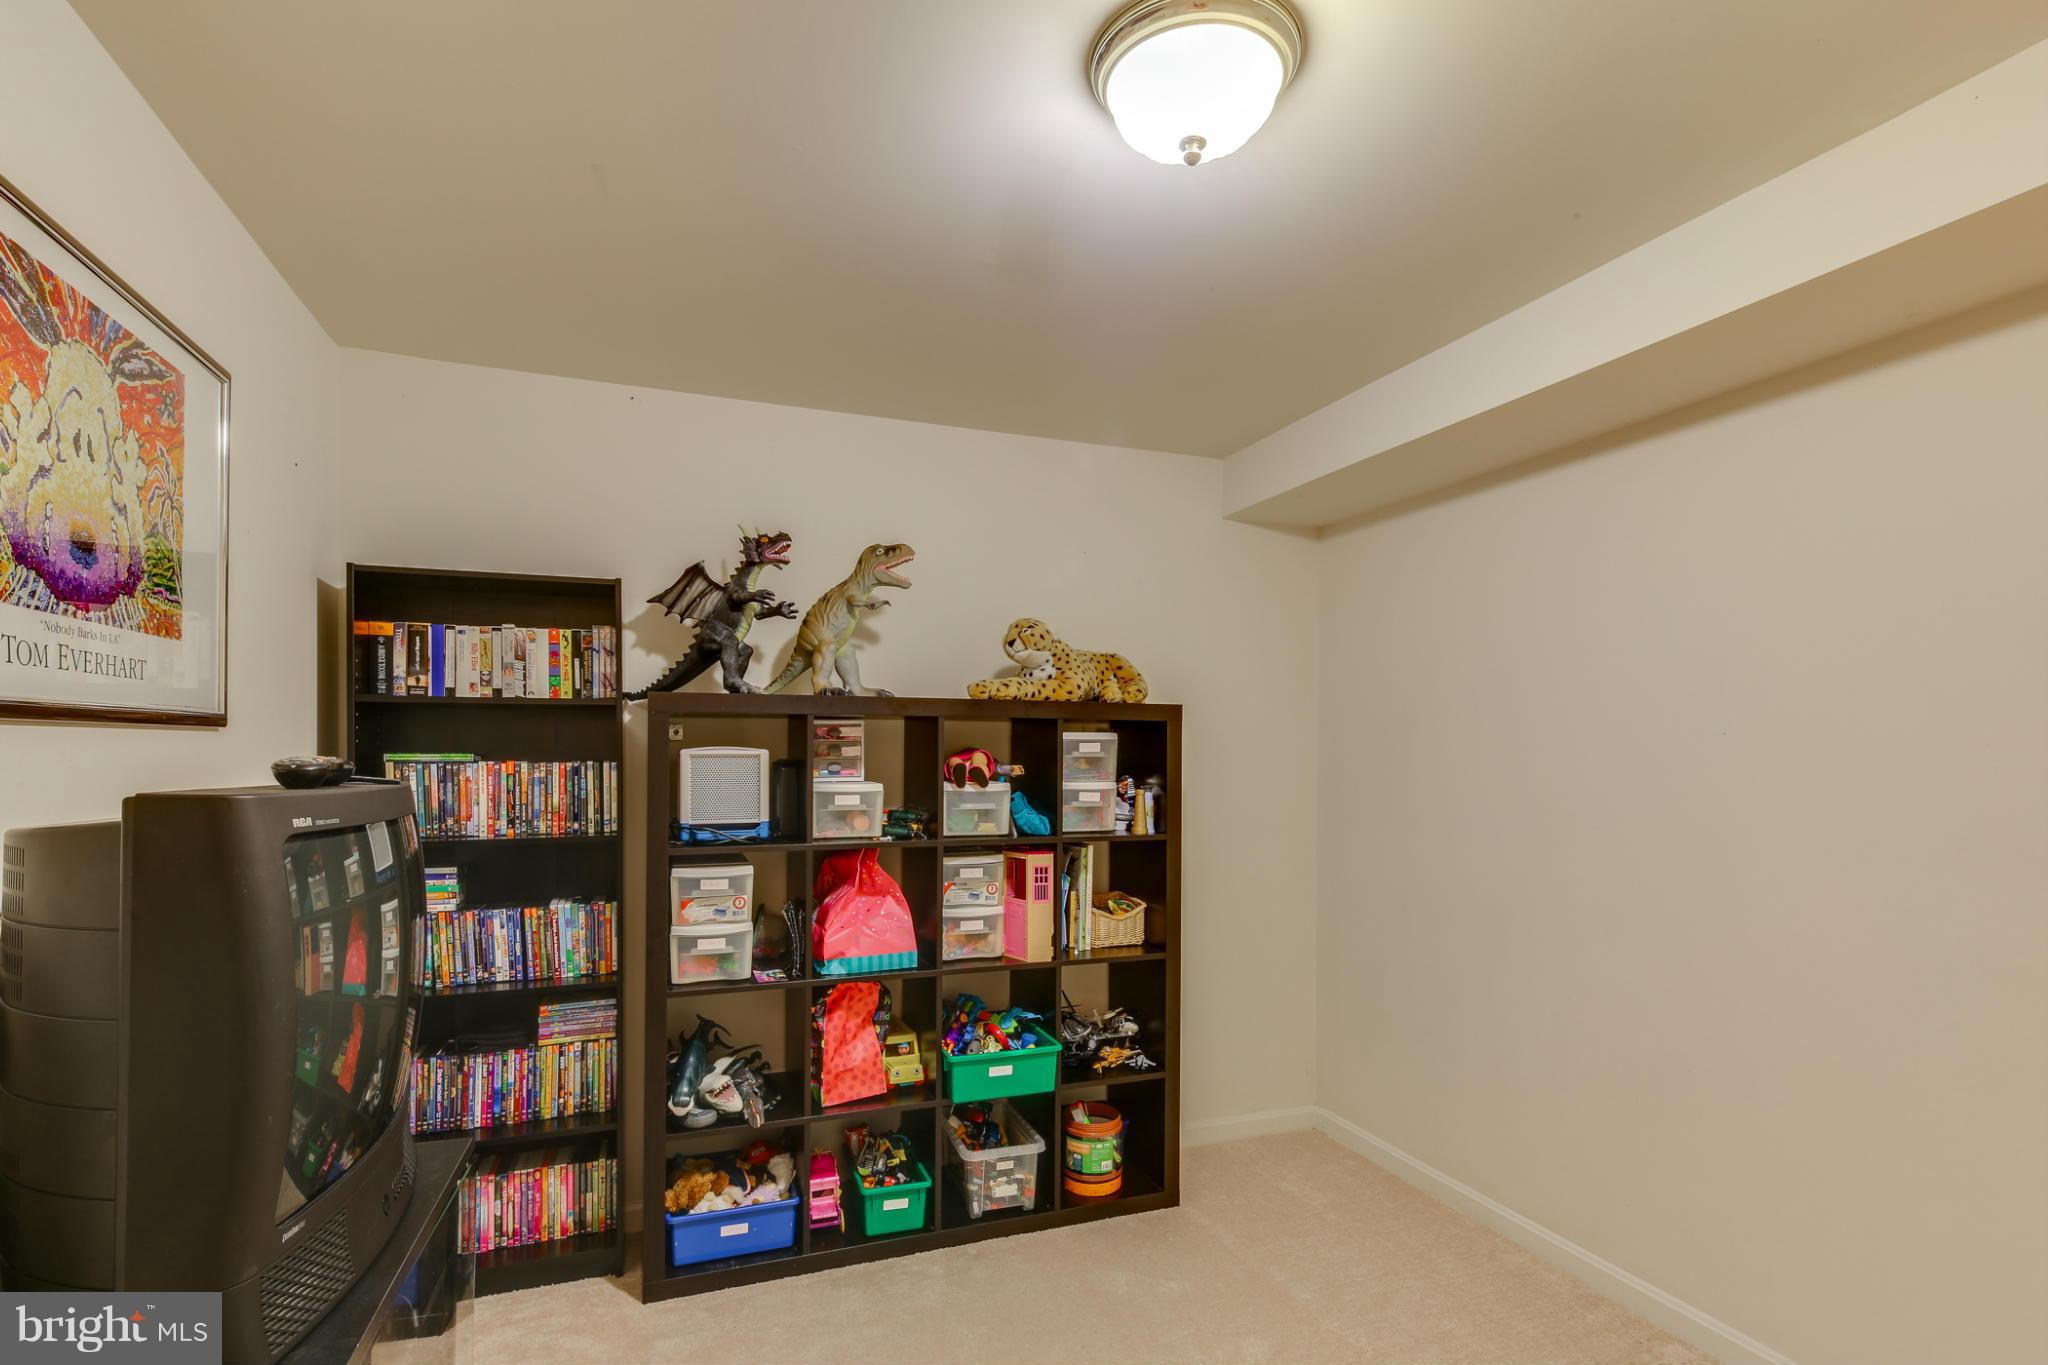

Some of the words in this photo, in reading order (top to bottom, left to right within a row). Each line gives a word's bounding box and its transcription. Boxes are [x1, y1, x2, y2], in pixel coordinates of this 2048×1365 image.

[77, 626, 97, 641] Barks
[99, 631, 108, 642] In
[1, 633, 49, 668] TOM
[57, 643, 147, 680] EVERHART
[292, 817, 312, 828] RCA
